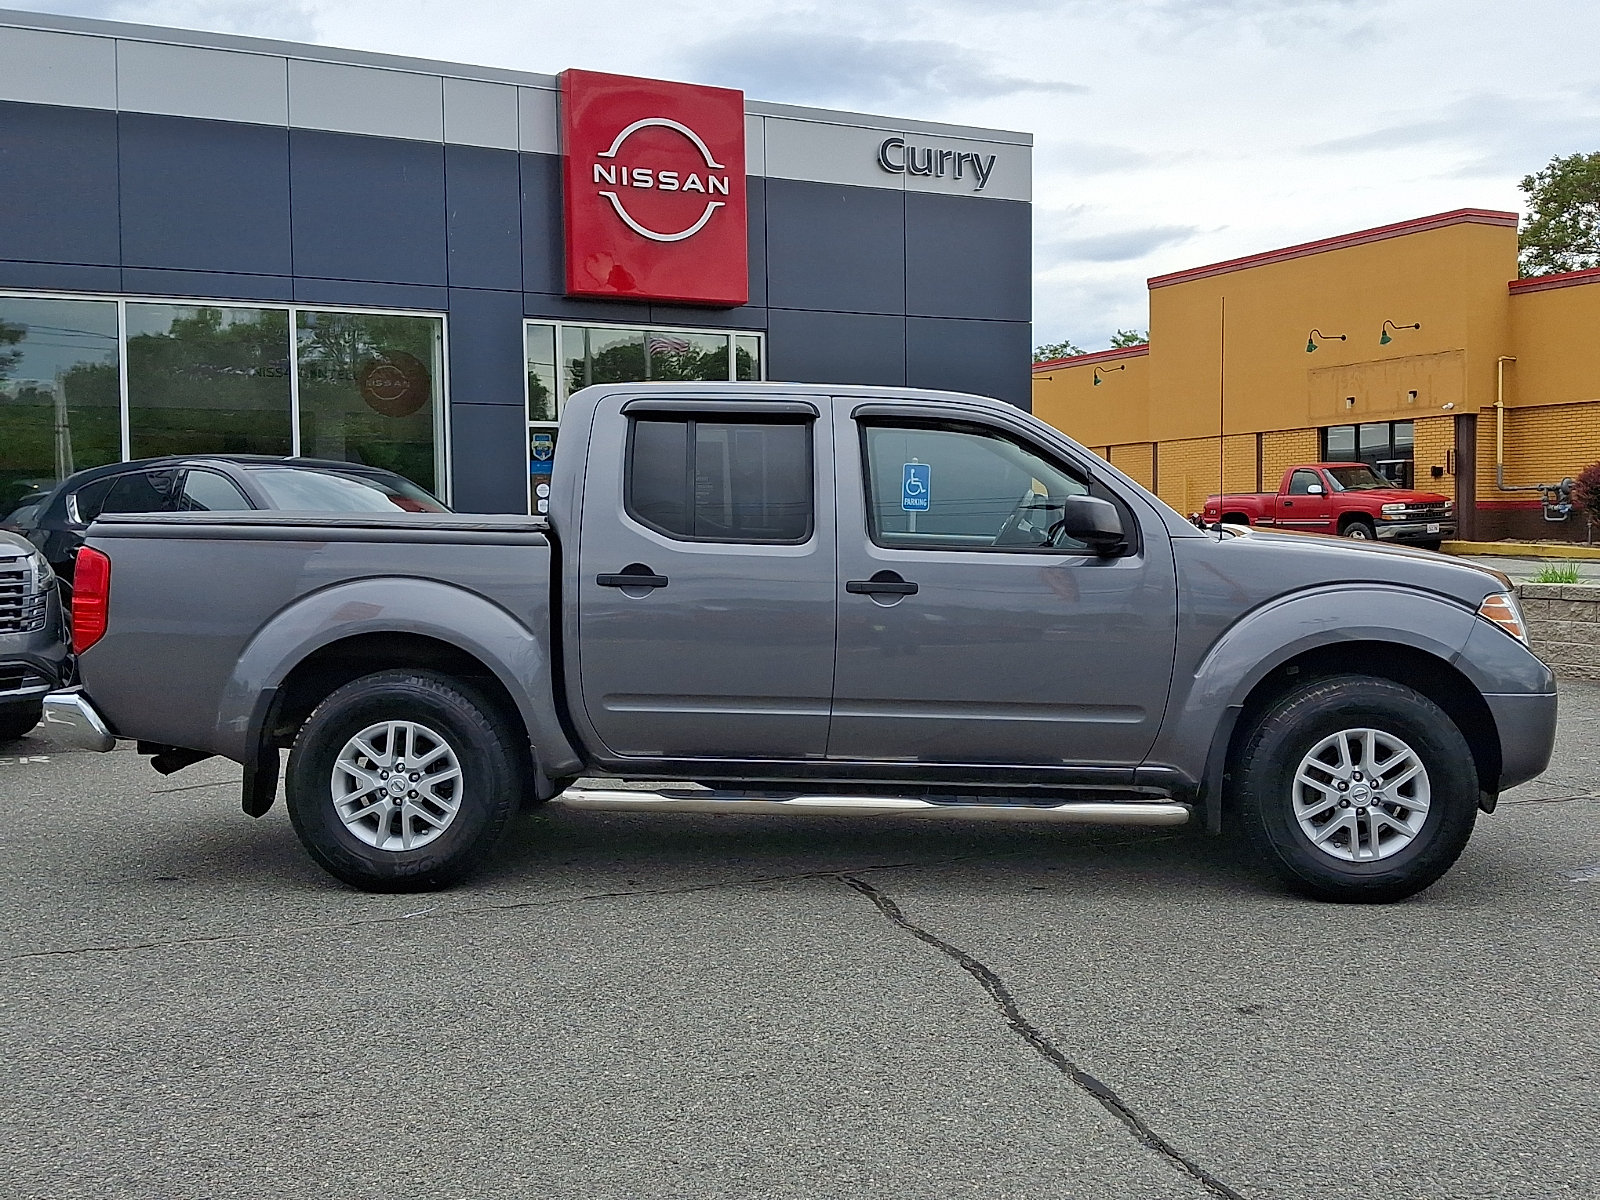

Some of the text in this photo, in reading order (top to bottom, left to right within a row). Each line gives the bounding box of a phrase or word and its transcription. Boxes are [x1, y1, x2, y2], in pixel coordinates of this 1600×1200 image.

[593, 163, 730, 195] NISSAN
[879, 136, 997, 190] Curry
[904, 498, 928, 507] PARKING
